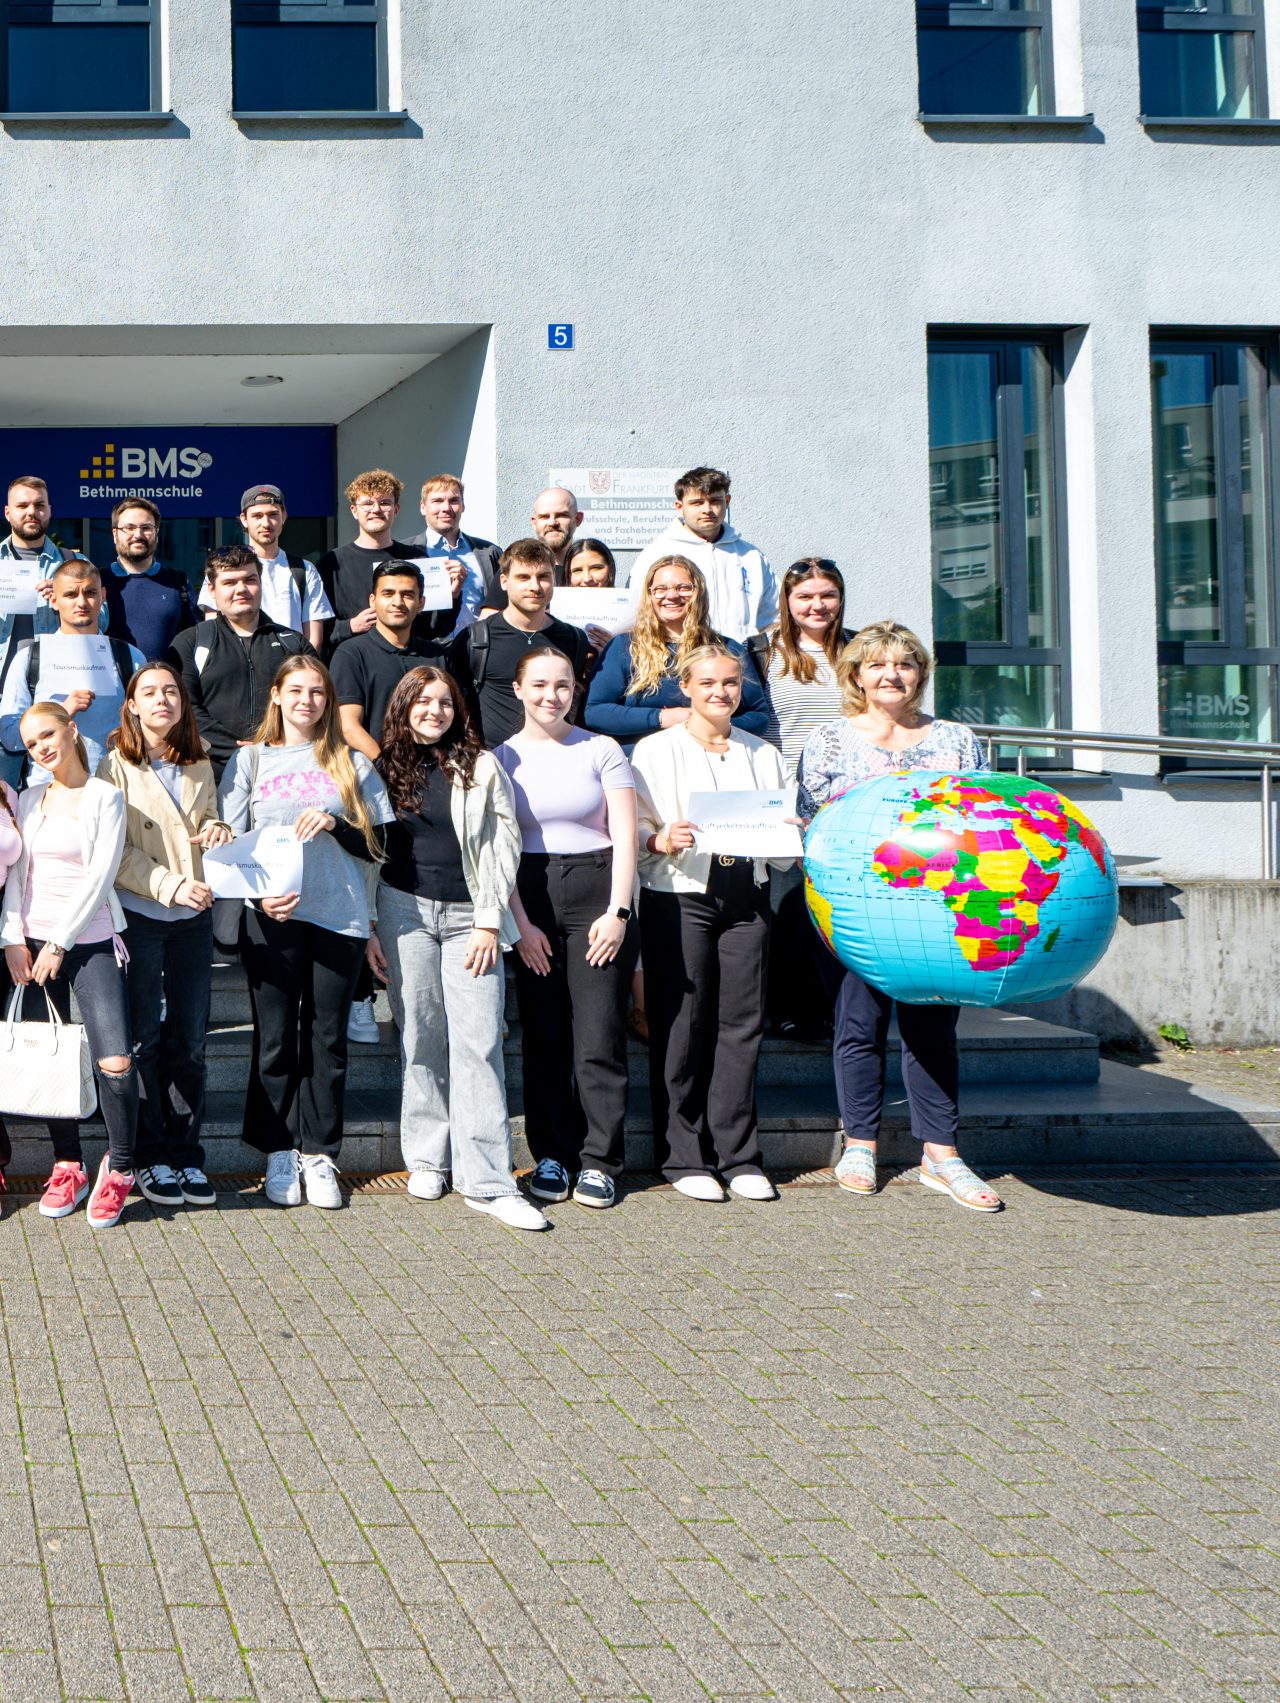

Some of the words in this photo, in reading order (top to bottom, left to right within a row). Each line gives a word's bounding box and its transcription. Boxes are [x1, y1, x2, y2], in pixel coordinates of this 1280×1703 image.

[555, 326, 567, 345] 5
[122, 447, 202, 478] BMS
[80, 485, 202, 497] Bethmannschule
[554, 479, 586, 493] SADT
[613, 480, 669, 494] FRANKFURT
[591, 499, 677, 509] Bethmannschu
[583, 515, 630, 523] rufsschule,
[1196, 694, 1250, 716] BMS
